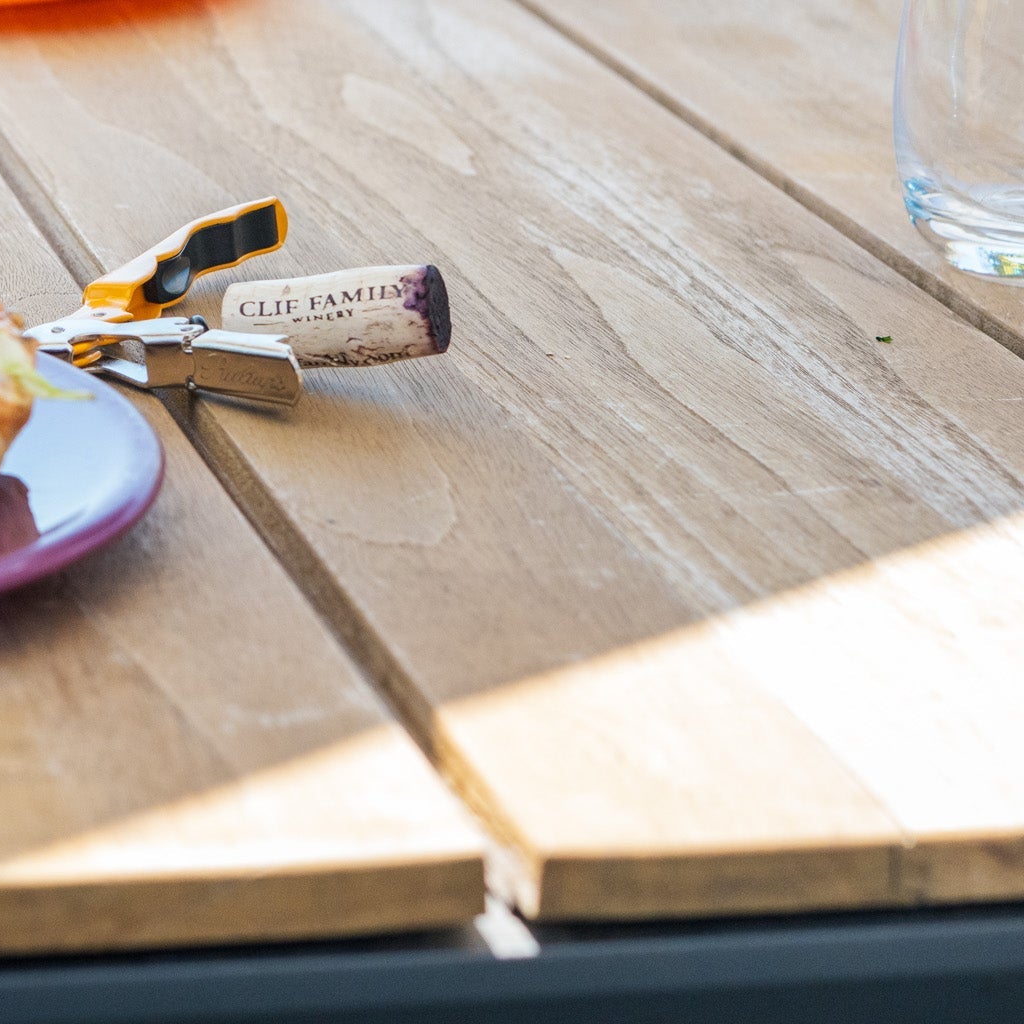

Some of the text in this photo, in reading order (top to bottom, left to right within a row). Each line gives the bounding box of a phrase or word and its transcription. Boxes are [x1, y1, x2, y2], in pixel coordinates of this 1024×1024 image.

[239, 283, 407, 318] CLIF FAMILY
[292, 308, 354, 324] WINERY
